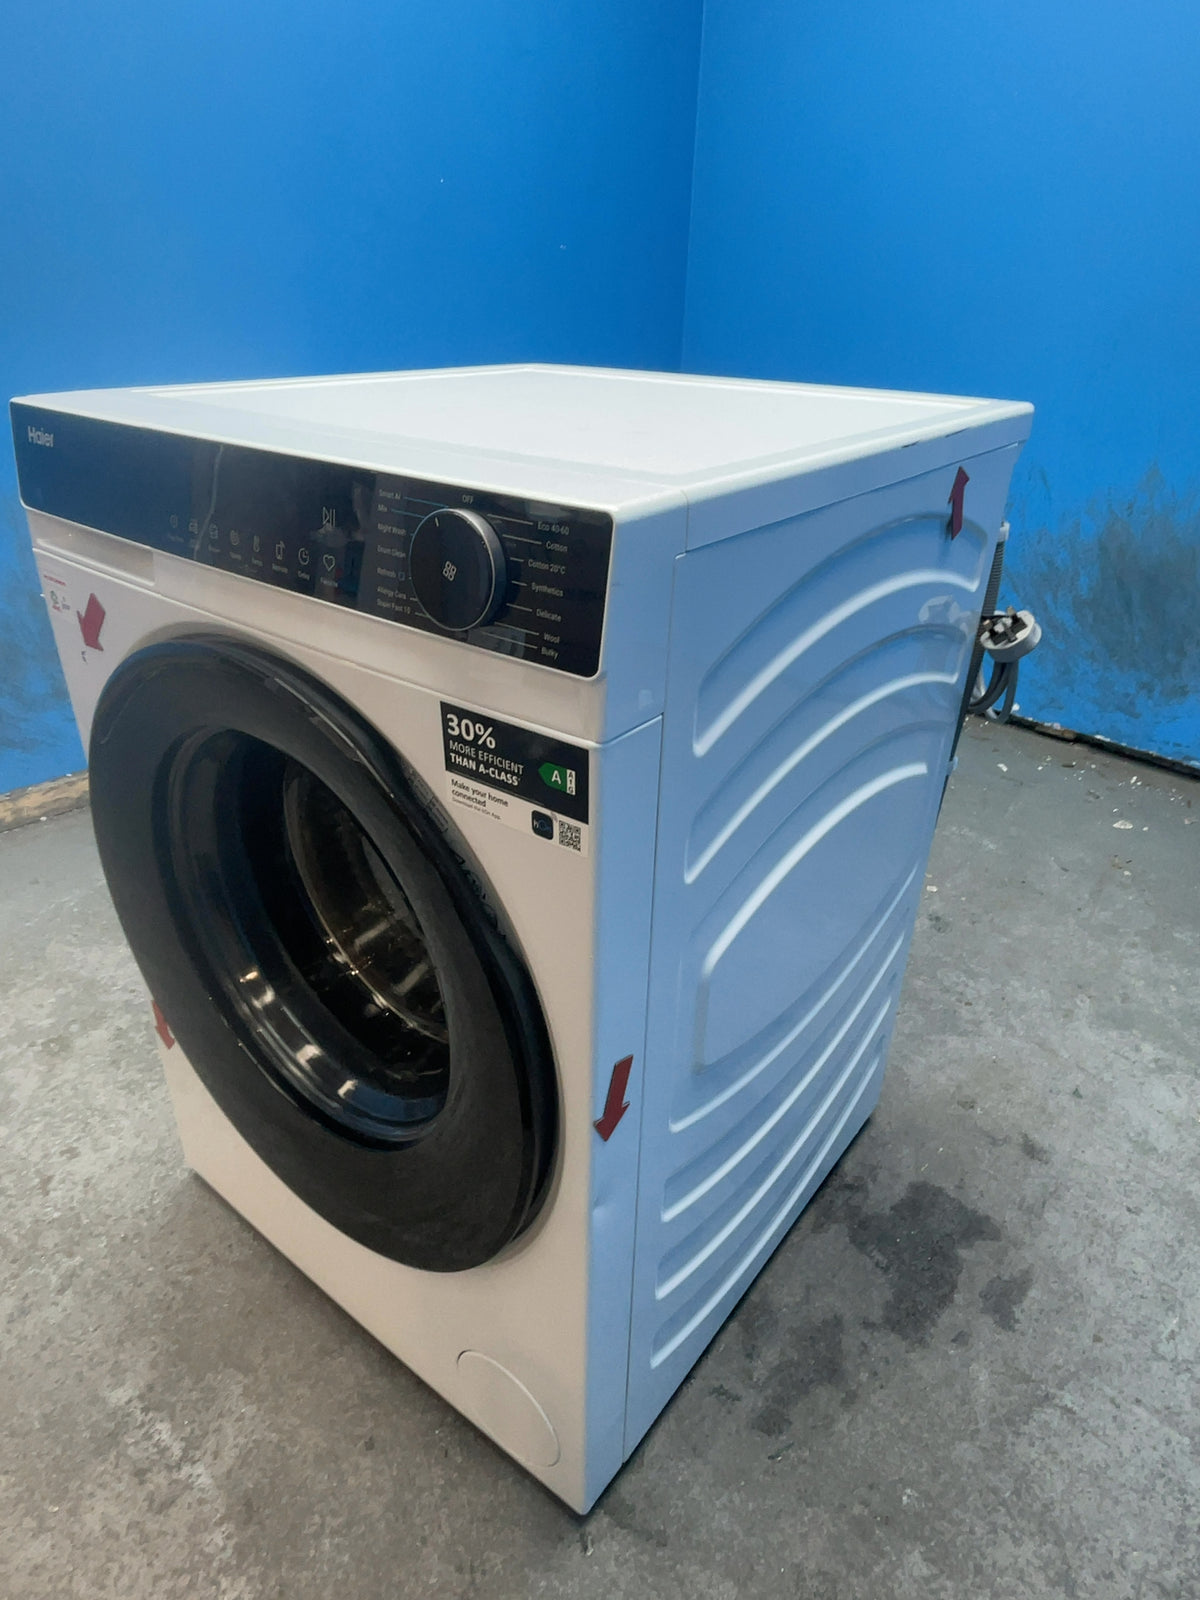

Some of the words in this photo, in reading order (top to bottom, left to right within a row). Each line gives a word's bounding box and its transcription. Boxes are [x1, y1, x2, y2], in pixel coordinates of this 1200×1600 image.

[28, 425, 54, 447] Haier
[462, 494, 474, 504] OFF
[537, 520, 550, 532] Eco
[551, 524, 569, 536] 40-60
[546, 540, 568, 553] Cotton
[528, 558, 549, 571] Cotton
[531, 581, 564, 598] Synthetics
[536, 608, 562, 623] Delicate
[543, 631, 560, 644] Wool
[541, 646, 559, 660] Bulky
[446, 713, 496, 749] 30%
[449, 739, 477, 758] MORE
[478, 750, 524, 775] EFFICIENT
[449, 752, 477, 772] THAN
[551, 770, 562, 785] A
[451, 779, 470, 792] Make
[471, 788, 487, 799] your
[488, 792, 509, 807] home
[451, 789, 487, 808] connected
